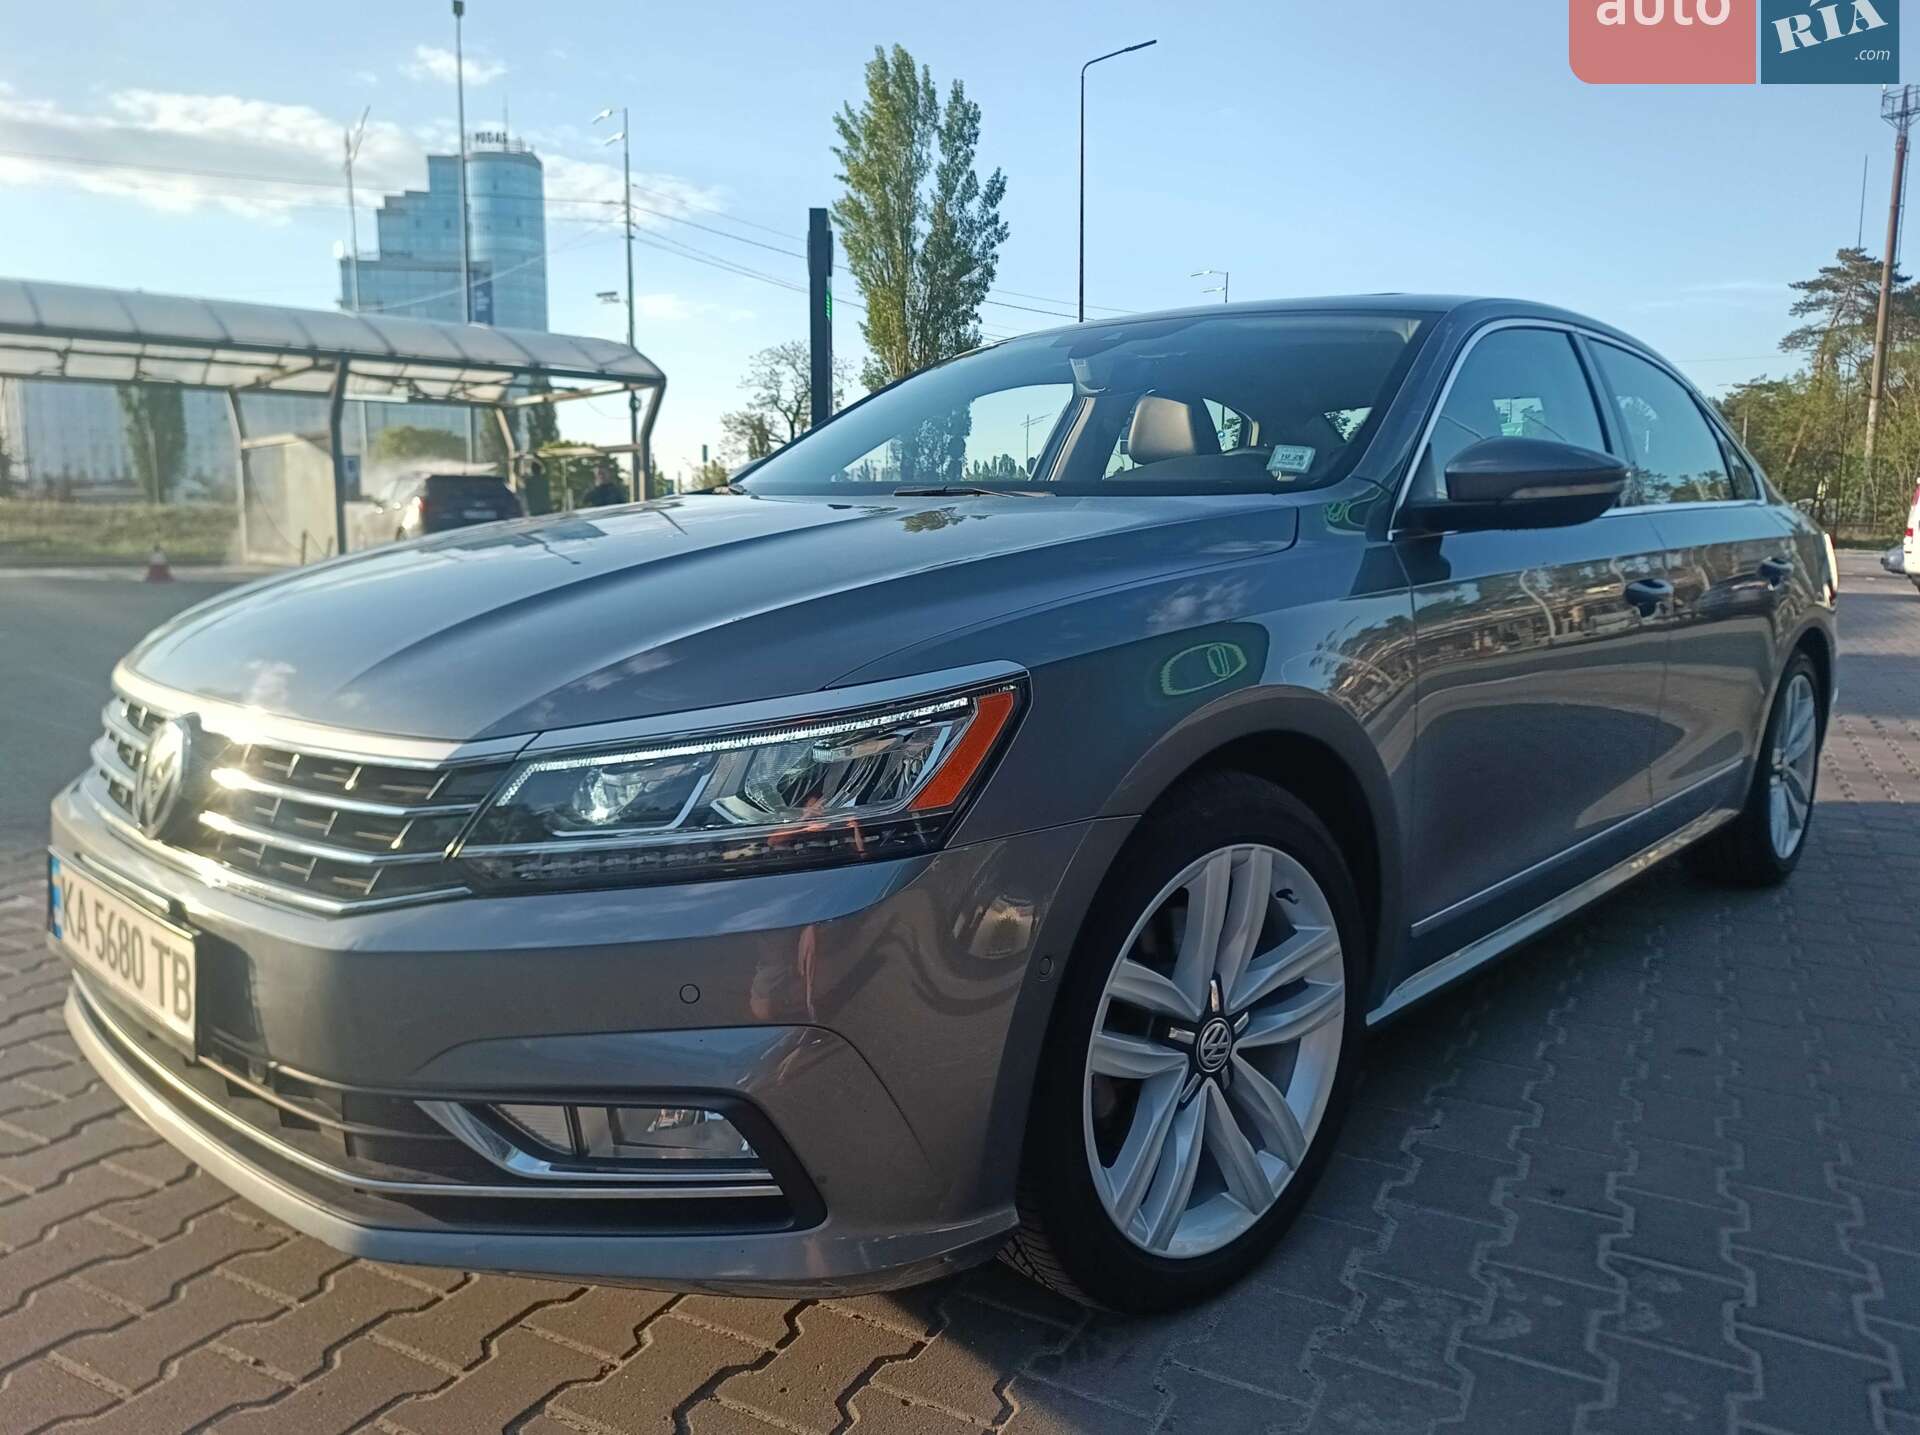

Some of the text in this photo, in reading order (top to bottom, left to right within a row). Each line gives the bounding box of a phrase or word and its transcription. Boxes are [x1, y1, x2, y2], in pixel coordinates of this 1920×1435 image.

[62, 876, 191, 1022] KA 5680 TB
